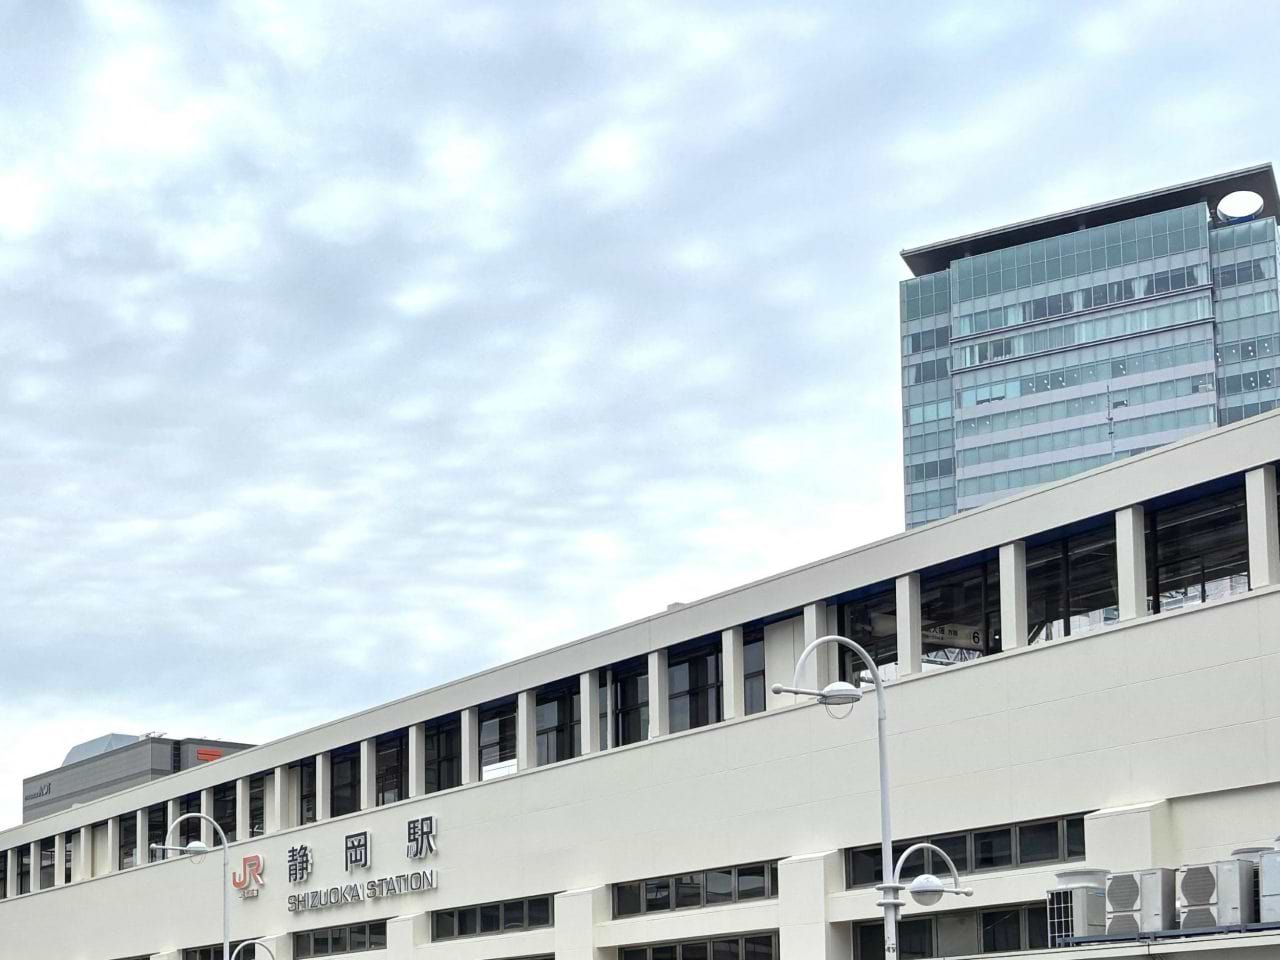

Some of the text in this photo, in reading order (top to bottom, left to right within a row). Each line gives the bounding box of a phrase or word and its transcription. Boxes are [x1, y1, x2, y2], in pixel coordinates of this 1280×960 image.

[972, 631, 980, 645] 6
[287, 815, 436, 884] 静岡駅
[232, 854, 265, 890] JR
[287, 870, 435, 913] SHIZUOKA STATION
